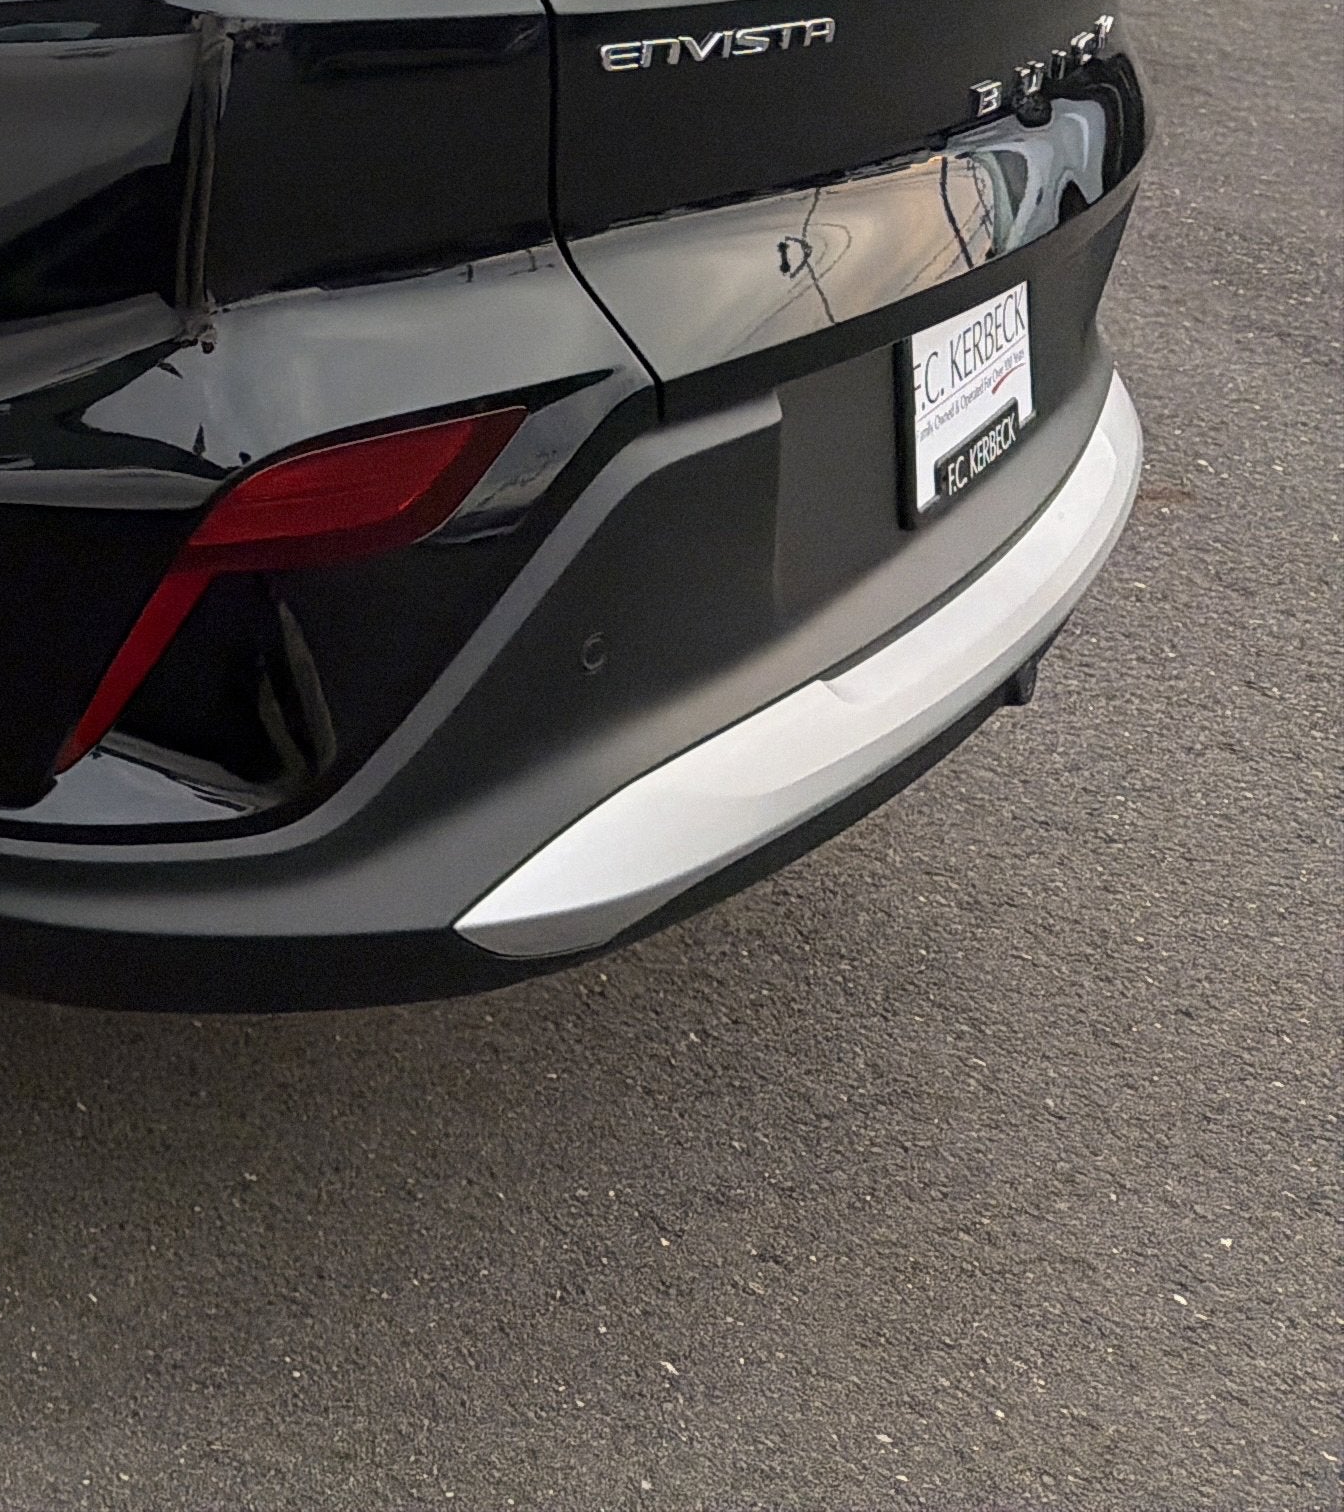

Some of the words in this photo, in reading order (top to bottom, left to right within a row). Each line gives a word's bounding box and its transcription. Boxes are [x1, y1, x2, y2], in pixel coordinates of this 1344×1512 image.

[949, 285, 1026, 389] KERBECK
[947, 455, 968, 496] F.C.
[969, 412, 1016, 479] KERBECK
